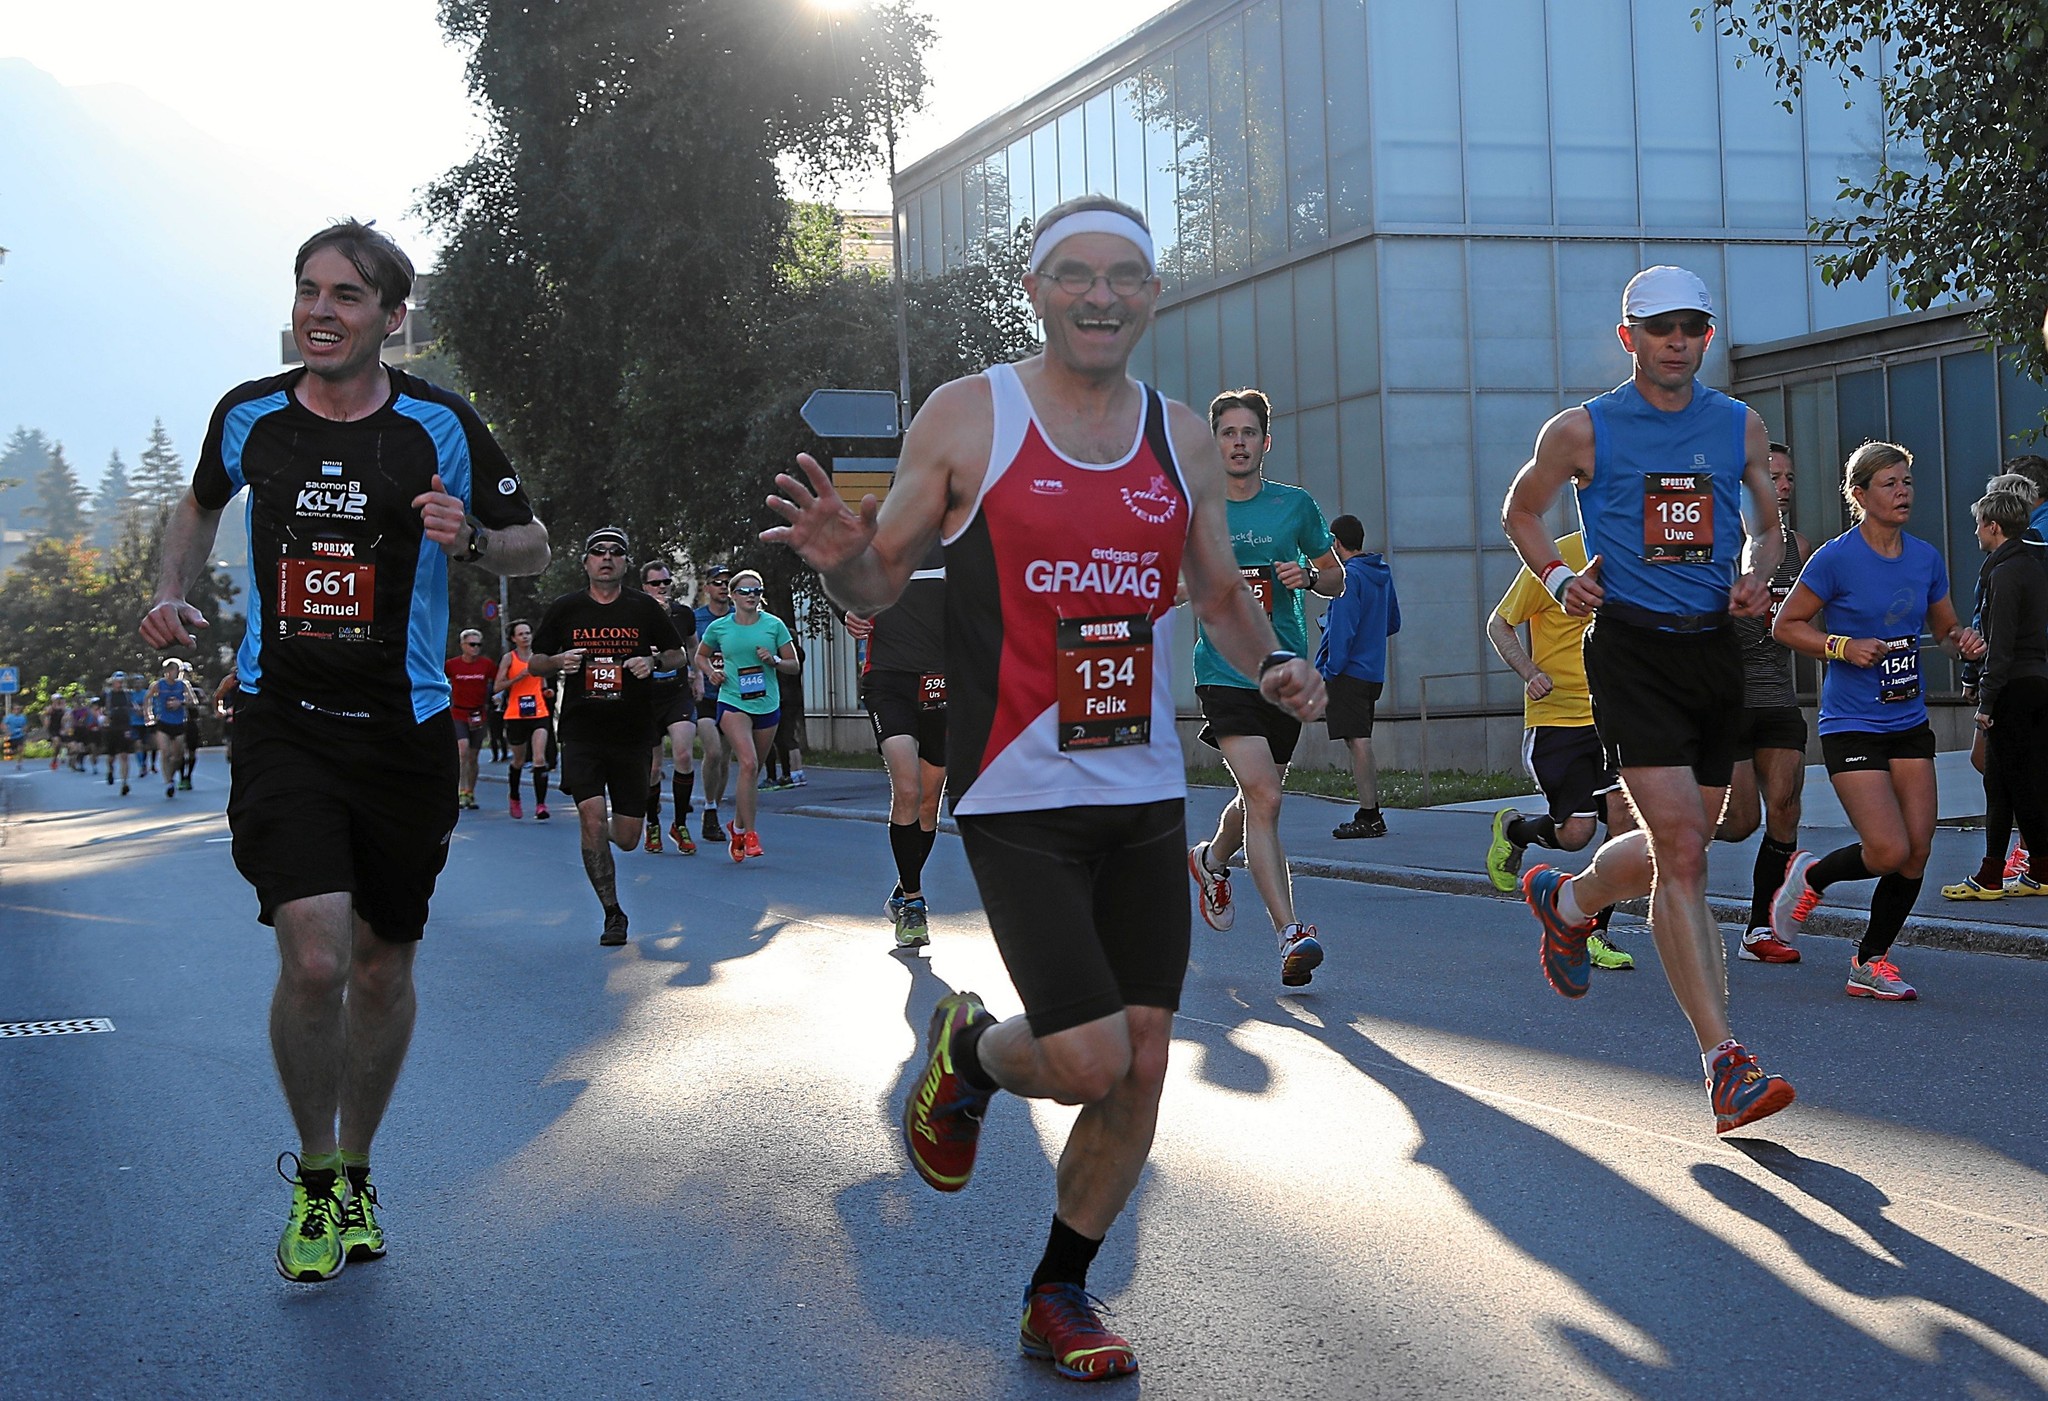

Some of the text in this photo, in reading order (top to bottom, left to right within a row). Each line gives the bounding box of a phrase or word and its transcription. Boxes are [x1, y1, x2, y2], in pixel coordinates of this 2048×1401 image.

[296, 511, 330, 519] ADVENTURE
[1656, 502, 1701, 524] 186
[1254, 535, 1273, 544] club
[1664, 528, 1695, 541] Uwe
[1091, 547, 1138, 564] erdgas
[305, 569, 355, 596] 661
[1024, 559, 1161, 599] GRAVAG
[303, 599, 359, 616] Samuel
[573, 627, 640, 639] FALCONS
[1881, 654, 1916, 675] 1541
[592, 668, 616, 680] 194
[1075, 656, 1135, 690] 134
[593, 681, 614, 690] Roger
[740, 675, 763, 687] 8446
[929, 691, 941, 699] Urs
[1086, 695, 1127, 716] Felix
